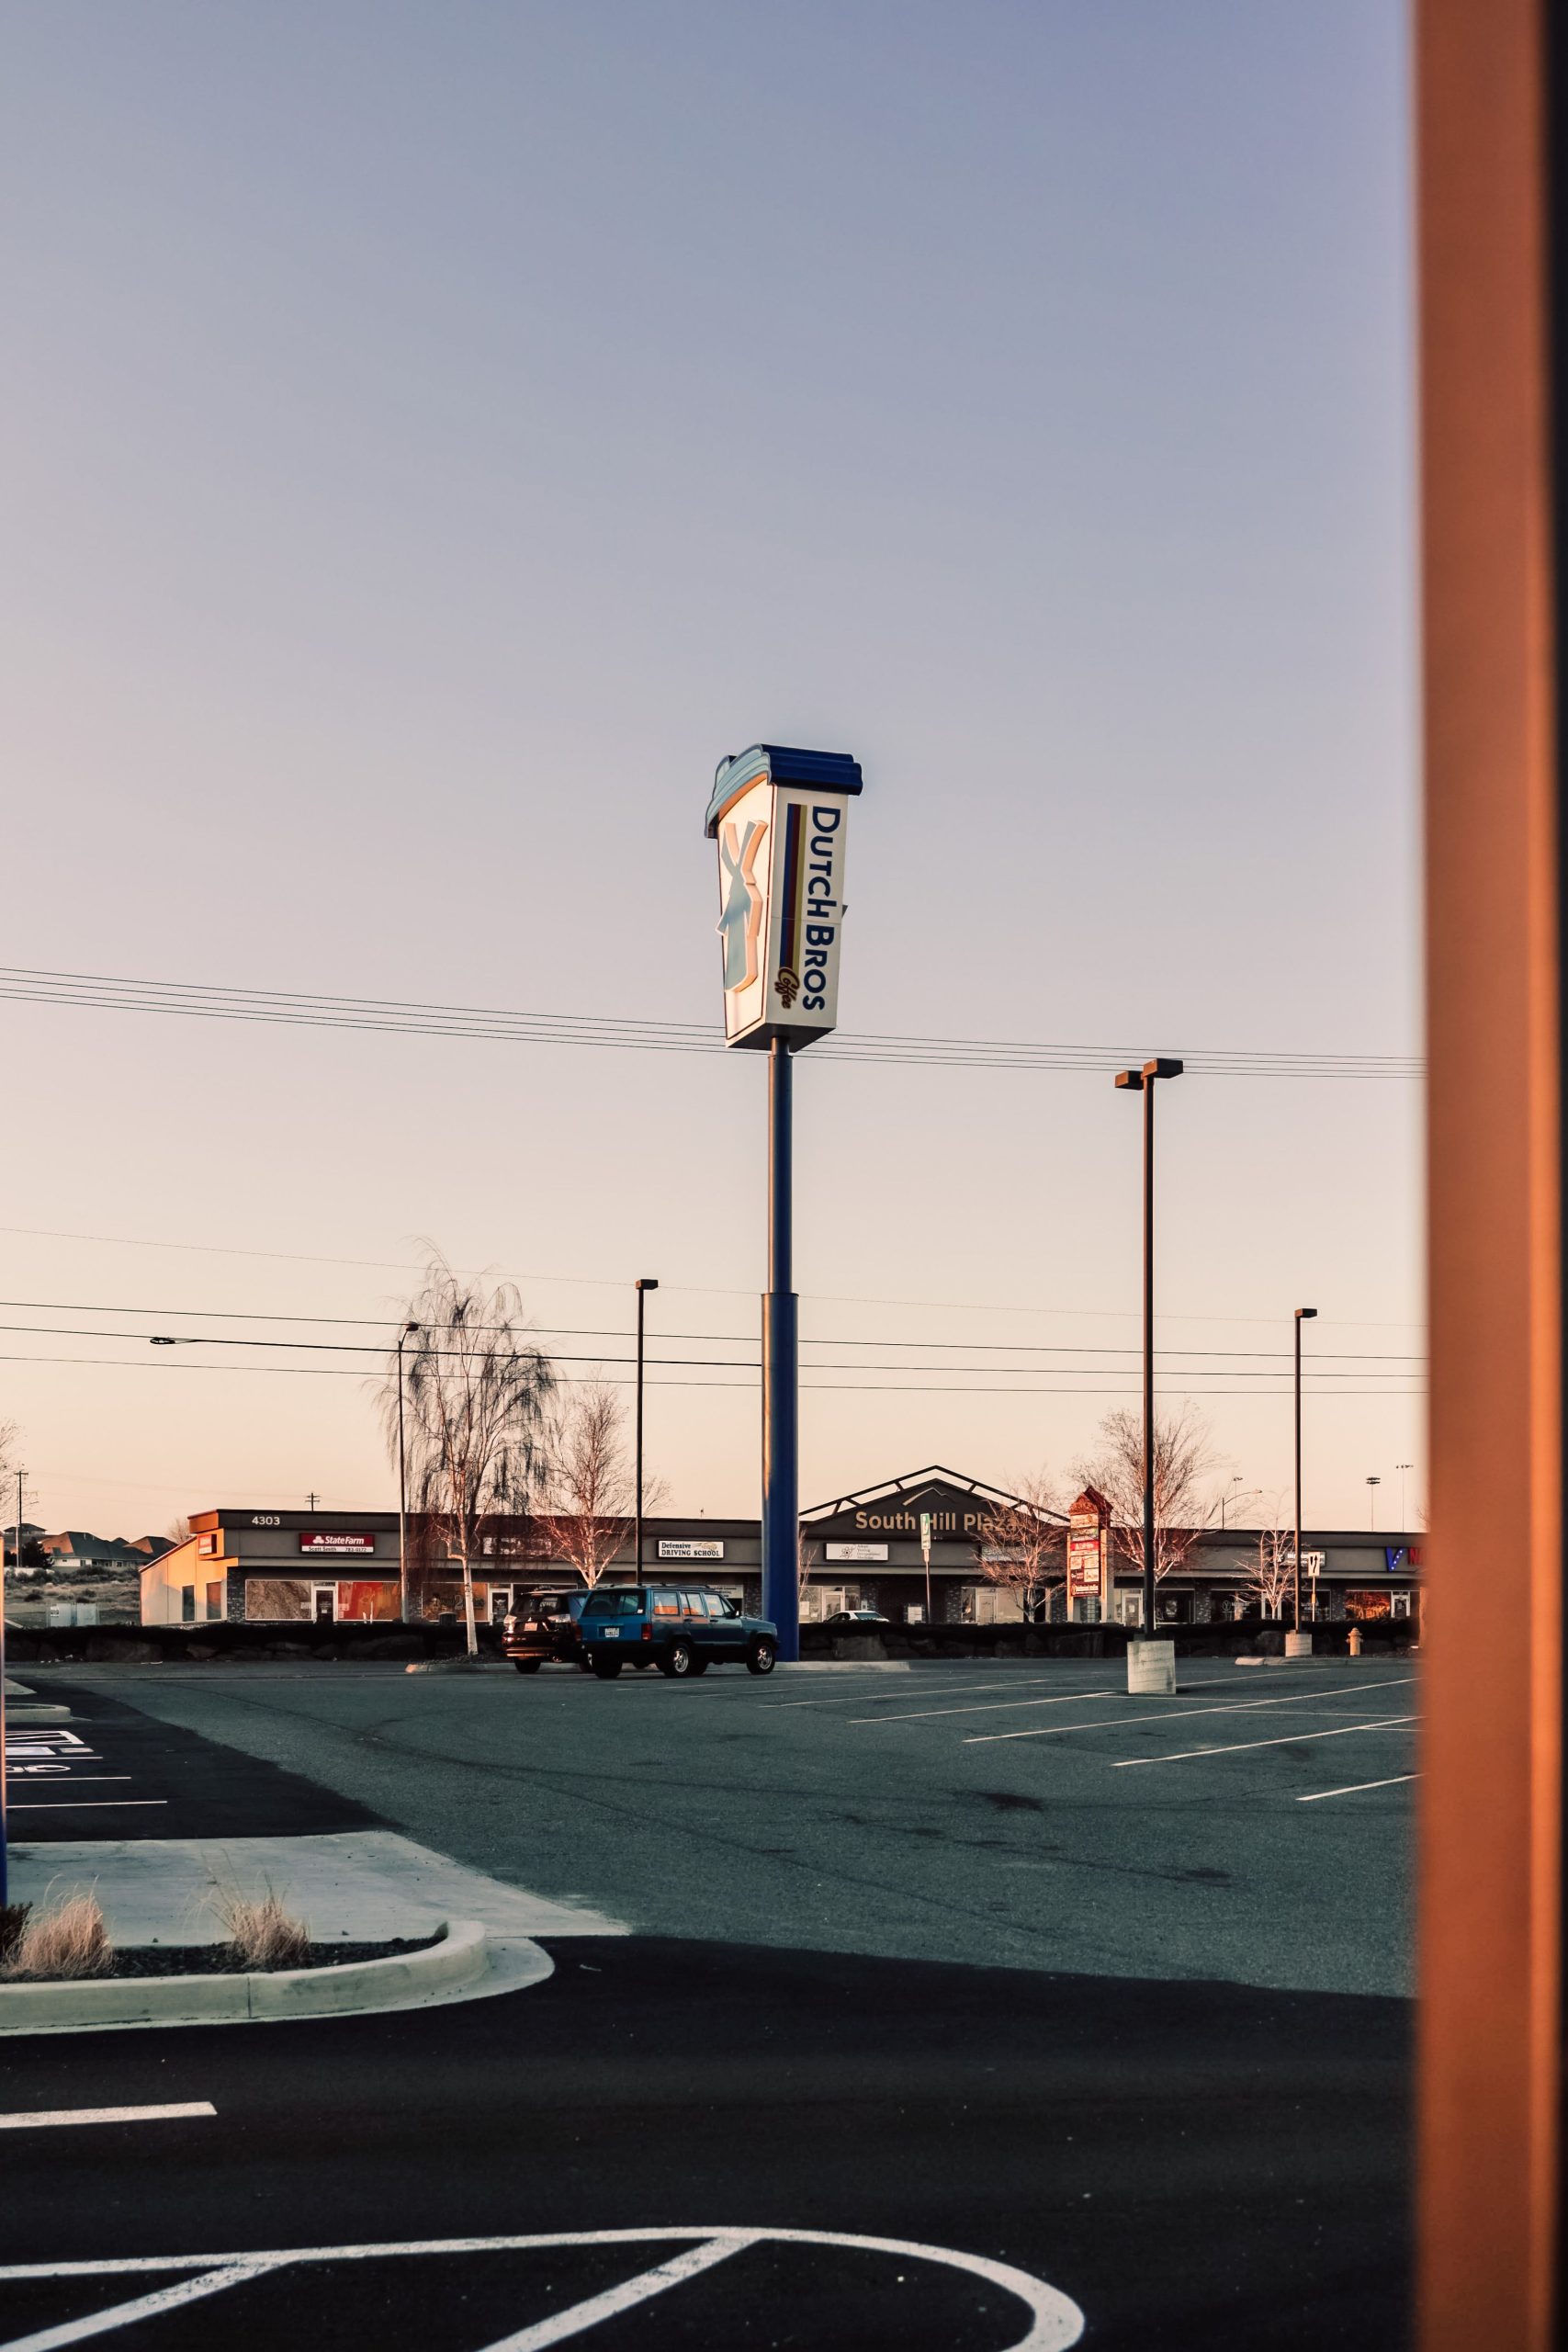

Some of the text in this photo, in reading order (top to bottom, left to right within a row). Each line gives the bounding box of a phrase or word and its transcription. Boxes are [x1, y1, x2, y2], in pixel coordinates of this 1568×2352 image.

[803, 806, 840, 1011] DUTCH BROS
[774, 967, 800, 1009] Coffee
[252, 1516, 280, 1526] 4303
[855, 1511, 916, 1530] South
